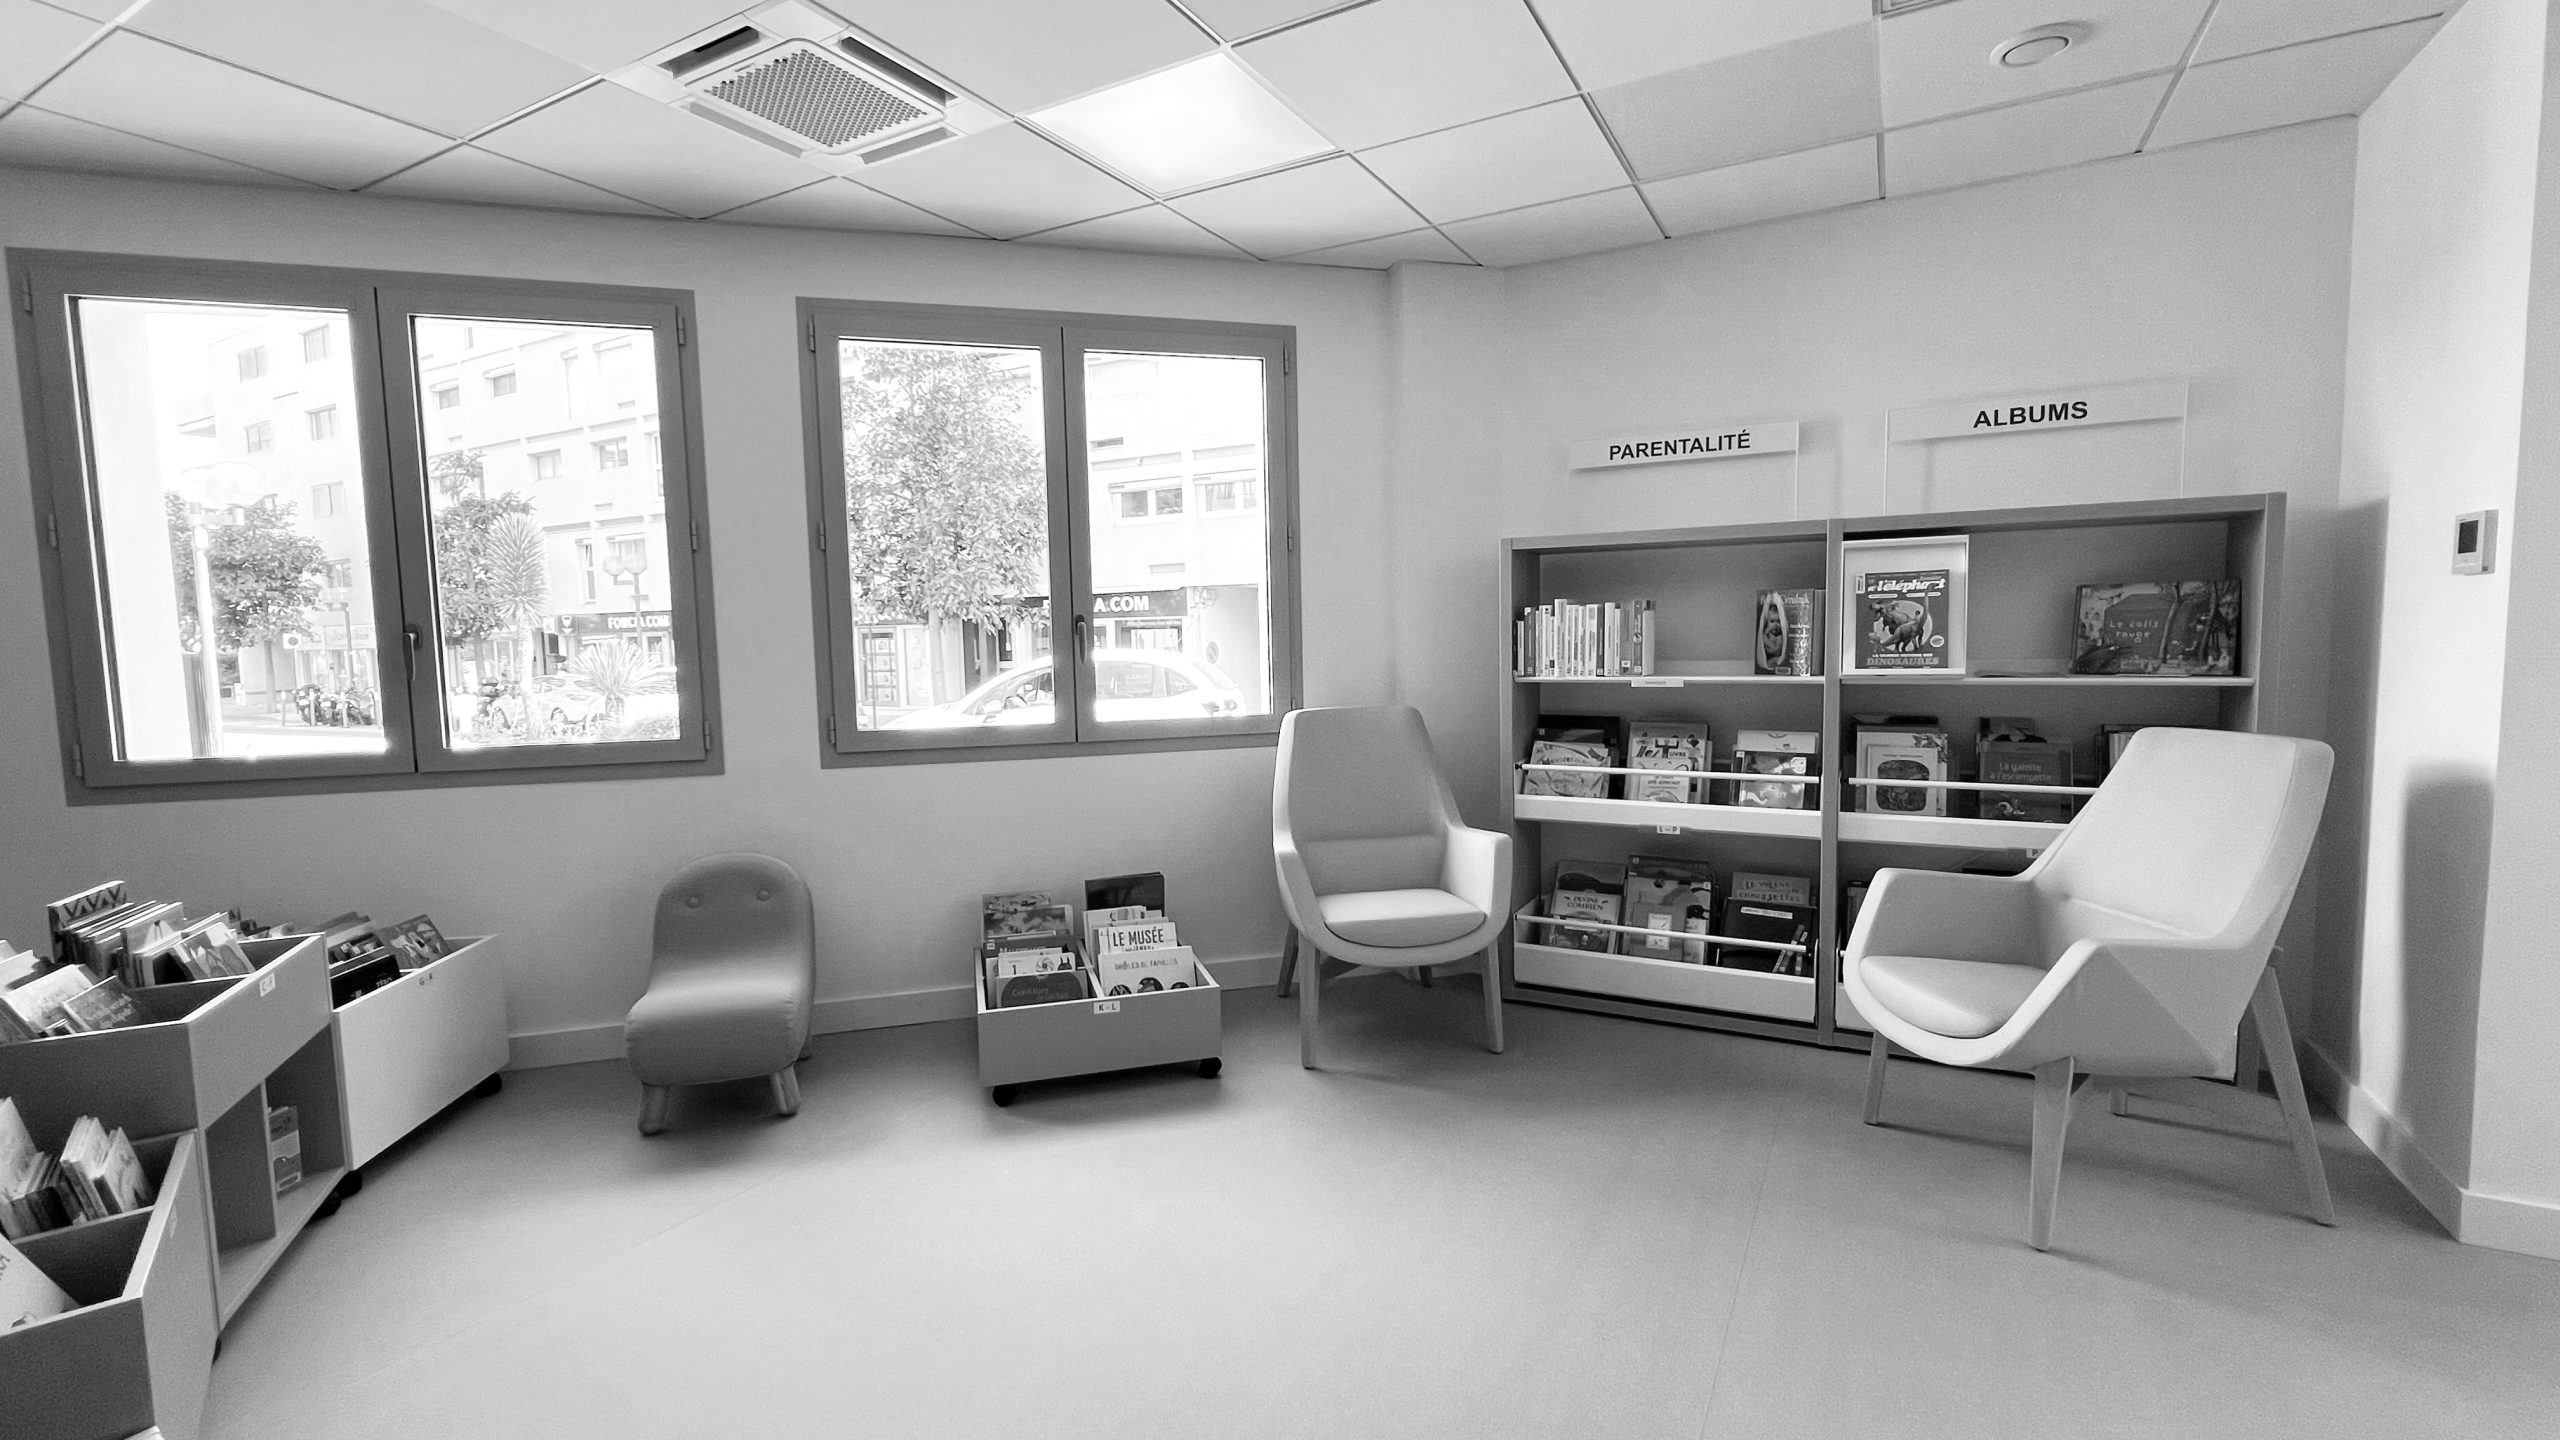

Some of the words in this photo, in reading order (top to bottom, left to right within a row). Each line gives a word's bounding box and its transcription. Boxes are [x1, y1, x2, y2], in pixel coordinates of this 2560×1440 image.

[1973, 400, 2089, 429] ALBUMS
[1608, 428, 1751, 461] PARENTALITÉ
[1092, 594, 1150, 613] A.COM
[2116, 629, 2151, 643] rouge
[1866, 656, 1940, 666] DINOSAURES
[1113, 931, 1126, 947] LE
[1128, 926, 1165, 946] MUSÉE
